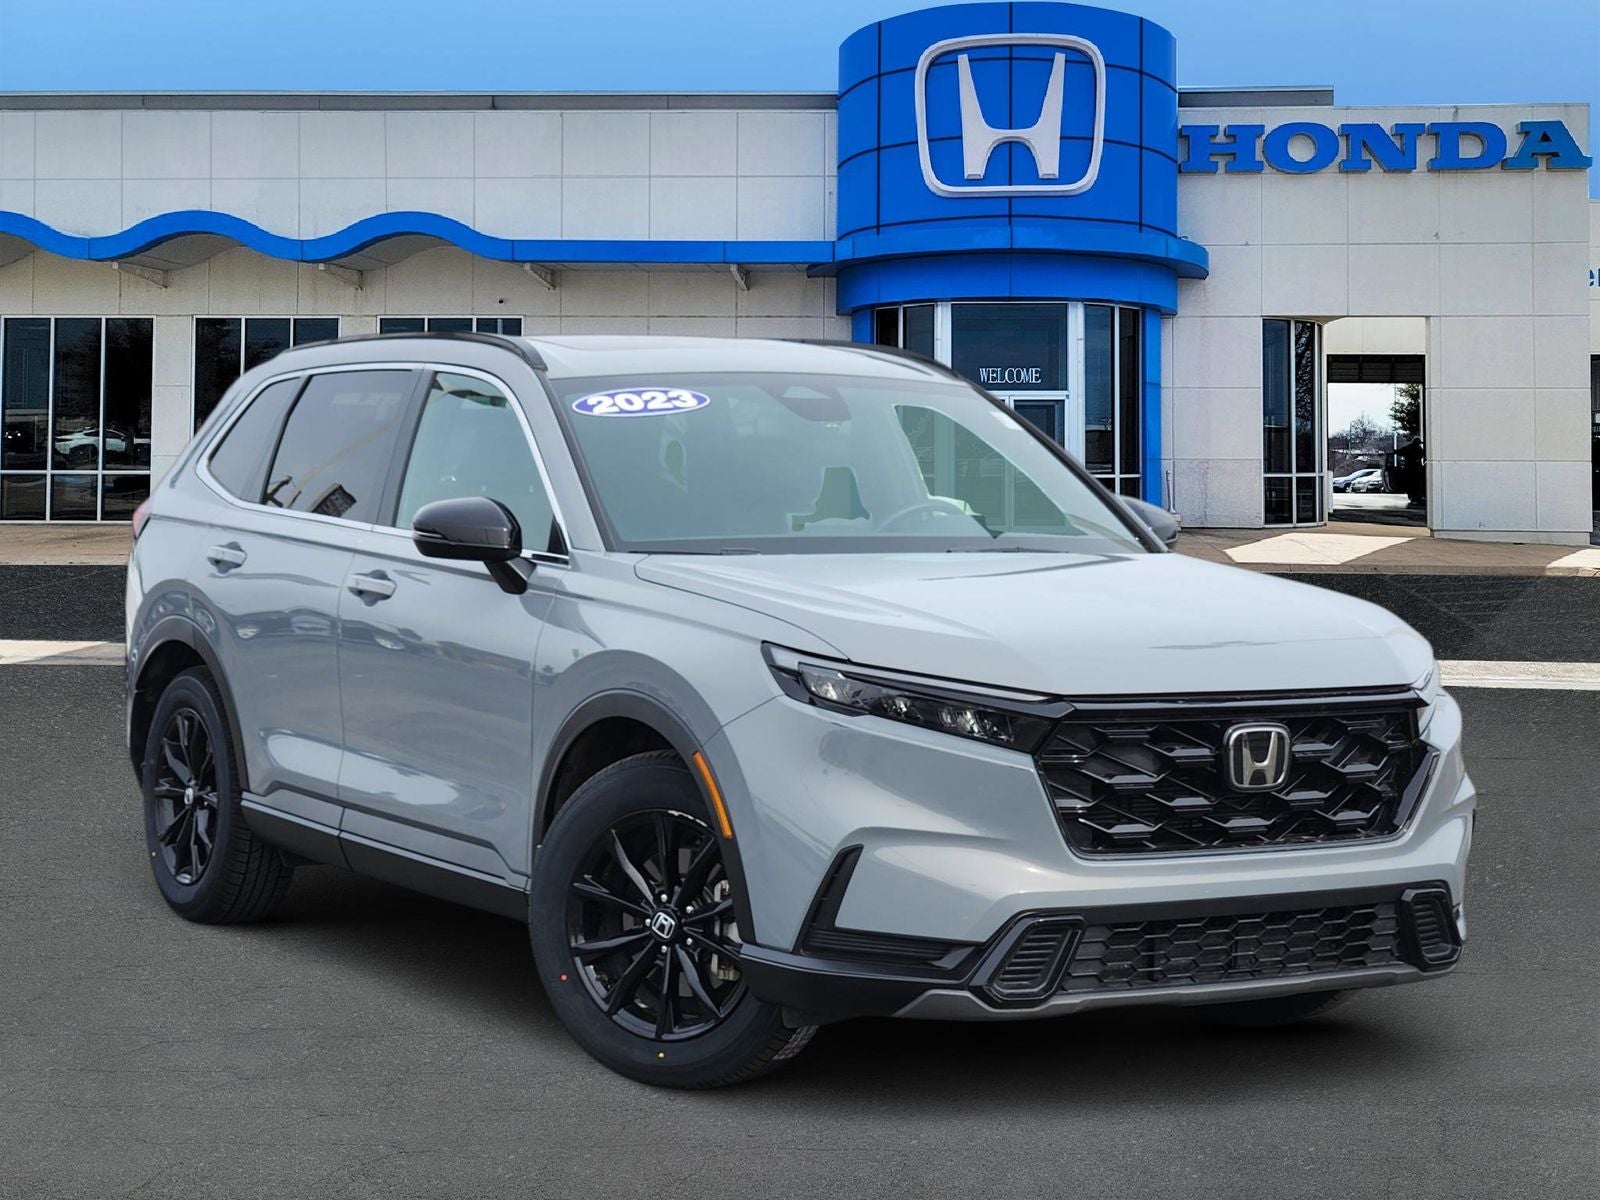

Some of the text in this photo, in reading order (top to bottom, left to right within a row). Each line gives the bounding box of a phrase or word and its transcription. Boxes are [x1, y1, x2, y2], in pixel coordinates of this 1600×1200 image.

[957, 52, 1065, 179] H
[1177, 120, 1593, 174] HONDA
[586, 389, 699, 415] 2023
[979, 367, 1042, 384] WELCOME
[1242, 731, 1278, 786] H
